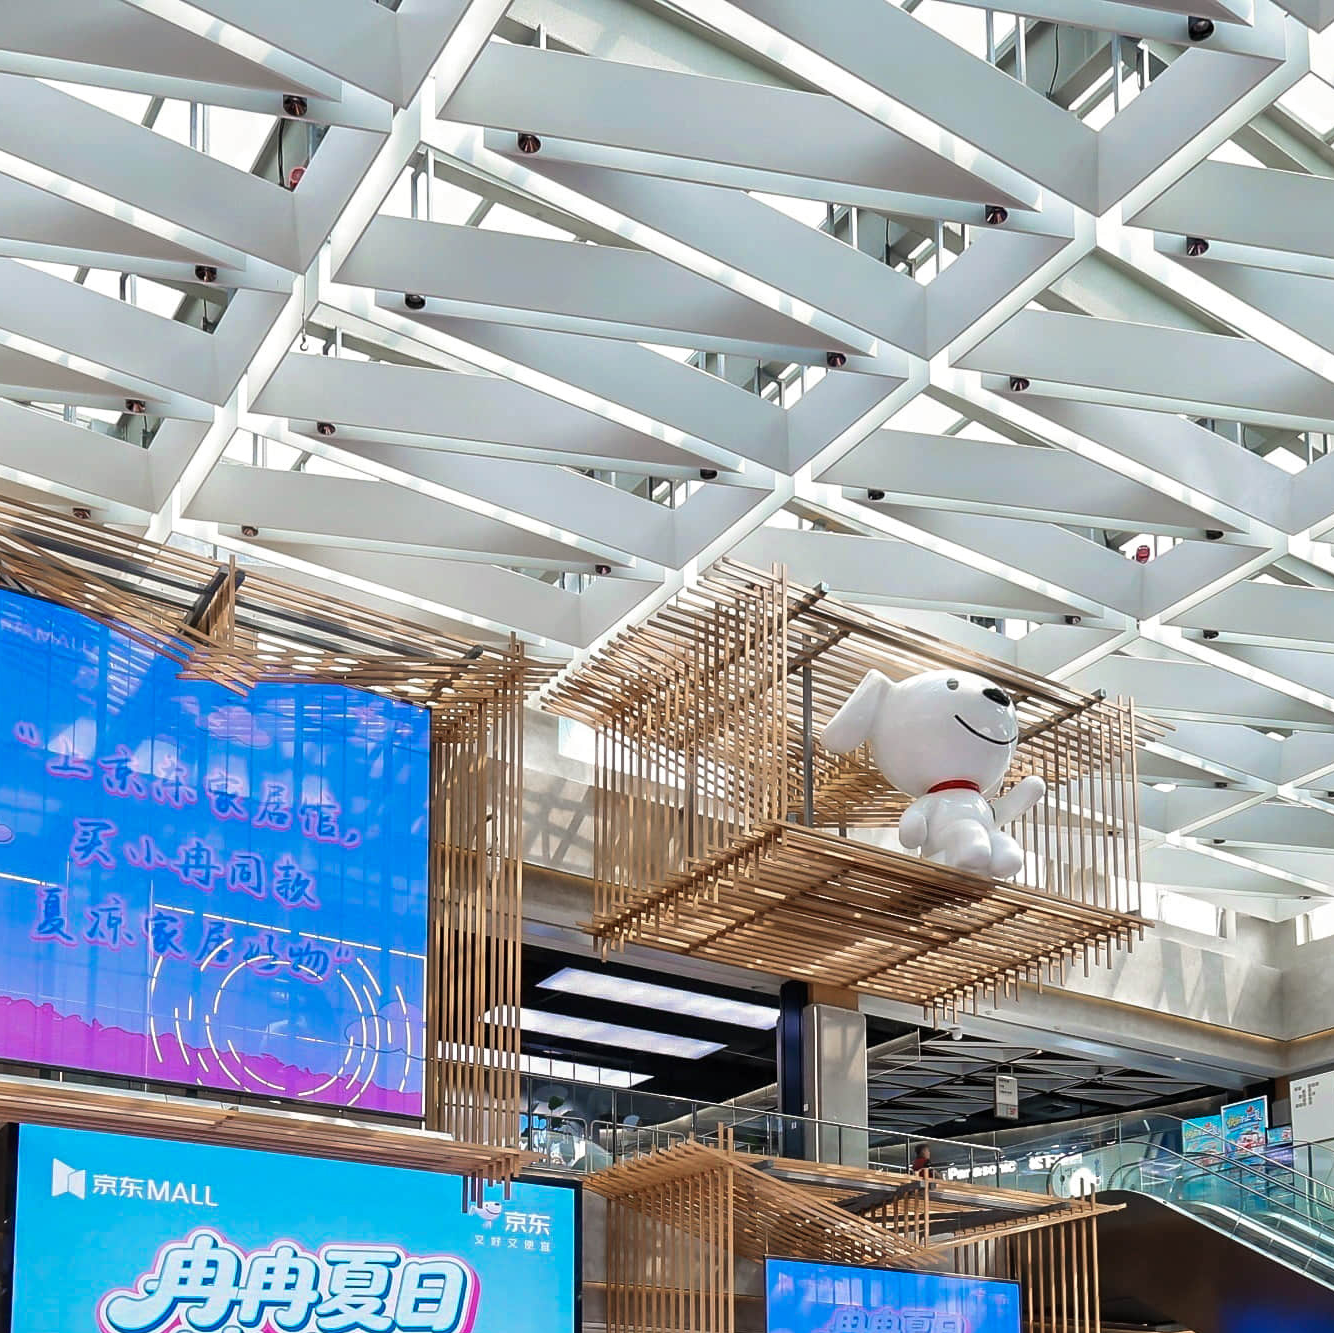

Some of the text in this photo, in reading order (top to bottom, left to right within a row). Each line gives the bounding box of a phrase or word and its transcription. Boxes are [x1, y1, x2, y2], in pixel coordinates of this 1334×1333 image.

[69, 818, 320, 909] 买小冉同款
[1294, 1081, 1319, 1109] 3F
[946, 1158, 1017, 1180] Panasonic
[92, 1173, 219, 1208] 京东MALL
[503, 1211, 552, 1236] 京东
